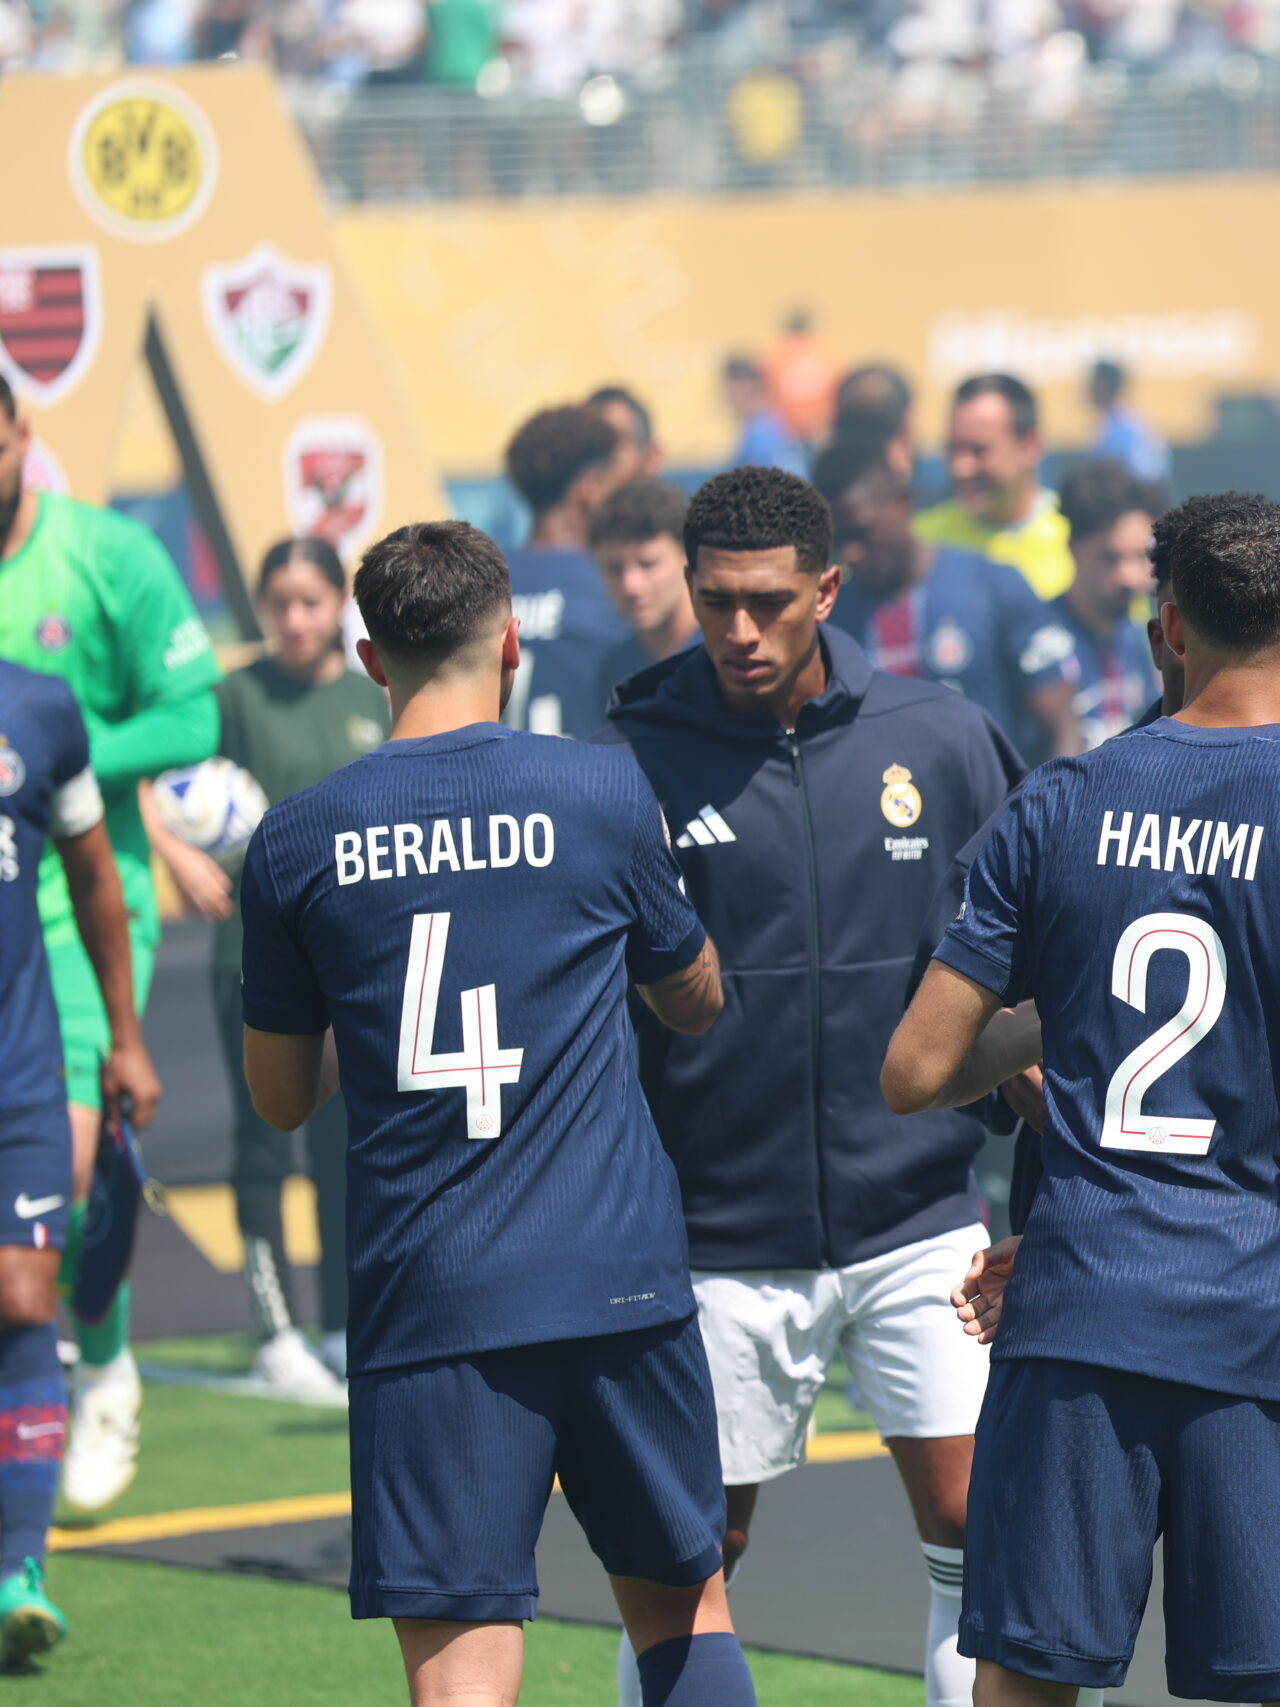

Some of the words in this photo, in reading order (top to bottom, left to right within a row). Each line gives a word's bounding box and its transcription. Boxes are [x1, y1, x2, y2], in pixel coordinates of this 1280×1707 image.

[334, 813, 555, 886] BERALDO
[1097, 810, 1264, 881] HAKIMI
[397, 912, 524, 1139] 4
[1100, 912, 1228, 1155] 2
